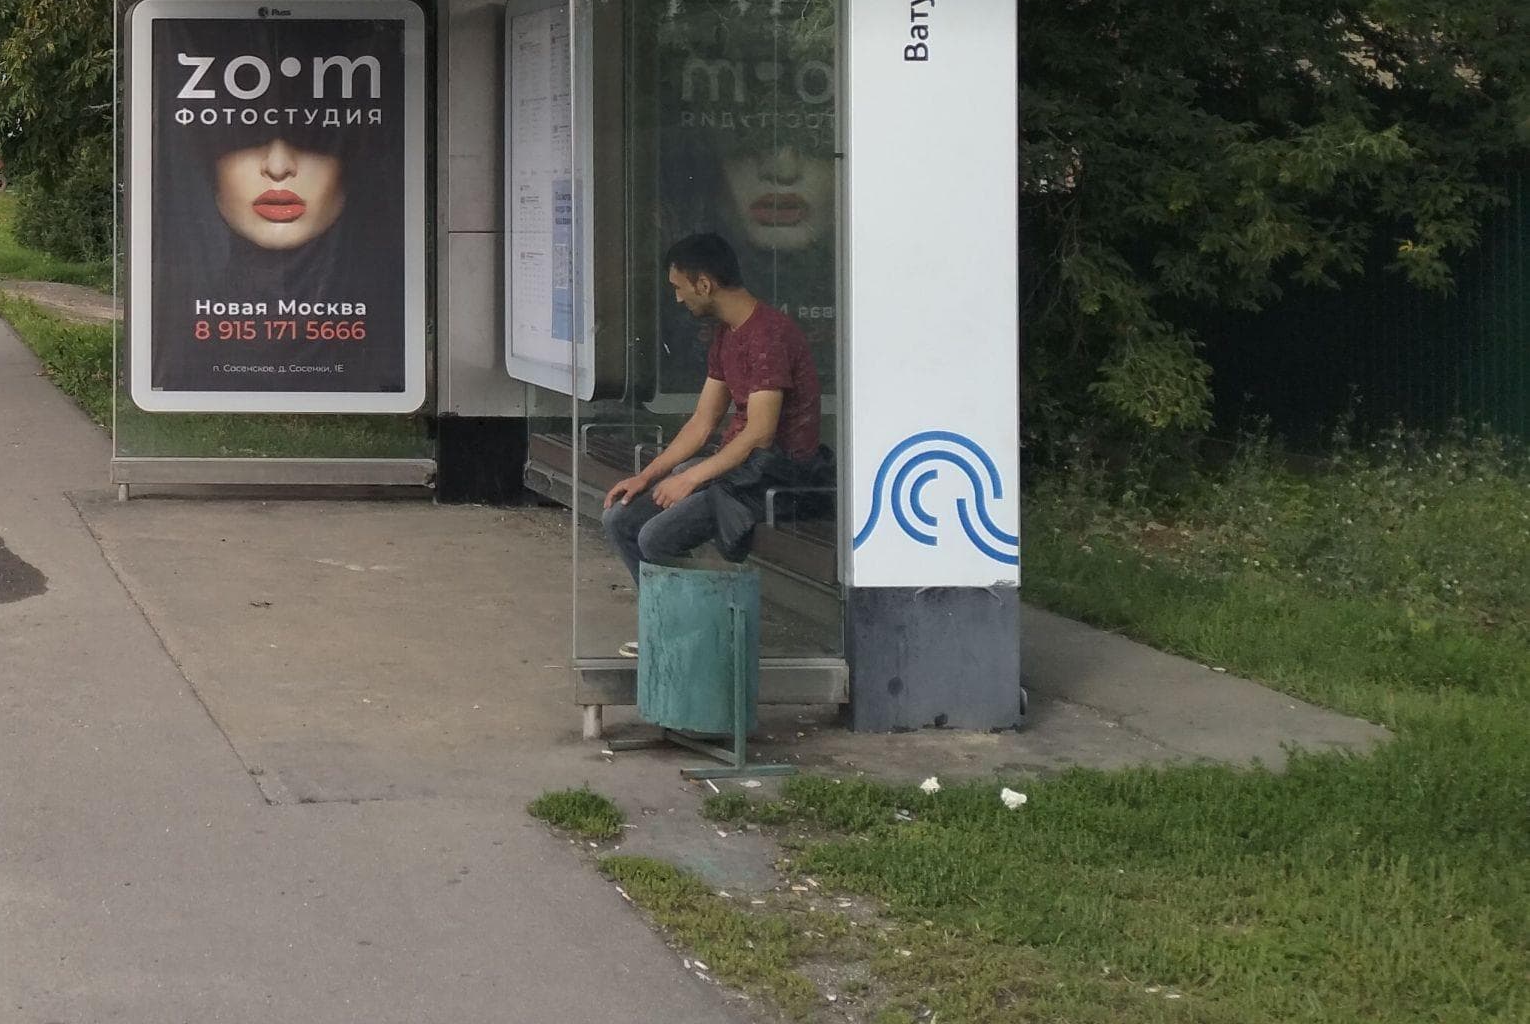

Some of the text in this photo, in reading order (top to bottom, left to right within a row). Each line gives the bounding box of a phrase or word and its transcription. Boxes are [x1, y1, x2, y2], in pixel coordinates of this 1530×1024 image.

[175, 108, 382, 127] ФОТОСТУДИЯ
[195, 299, 367, 316] Новая Москва
[195, 321, 366, 340] 8 915 171 5666
